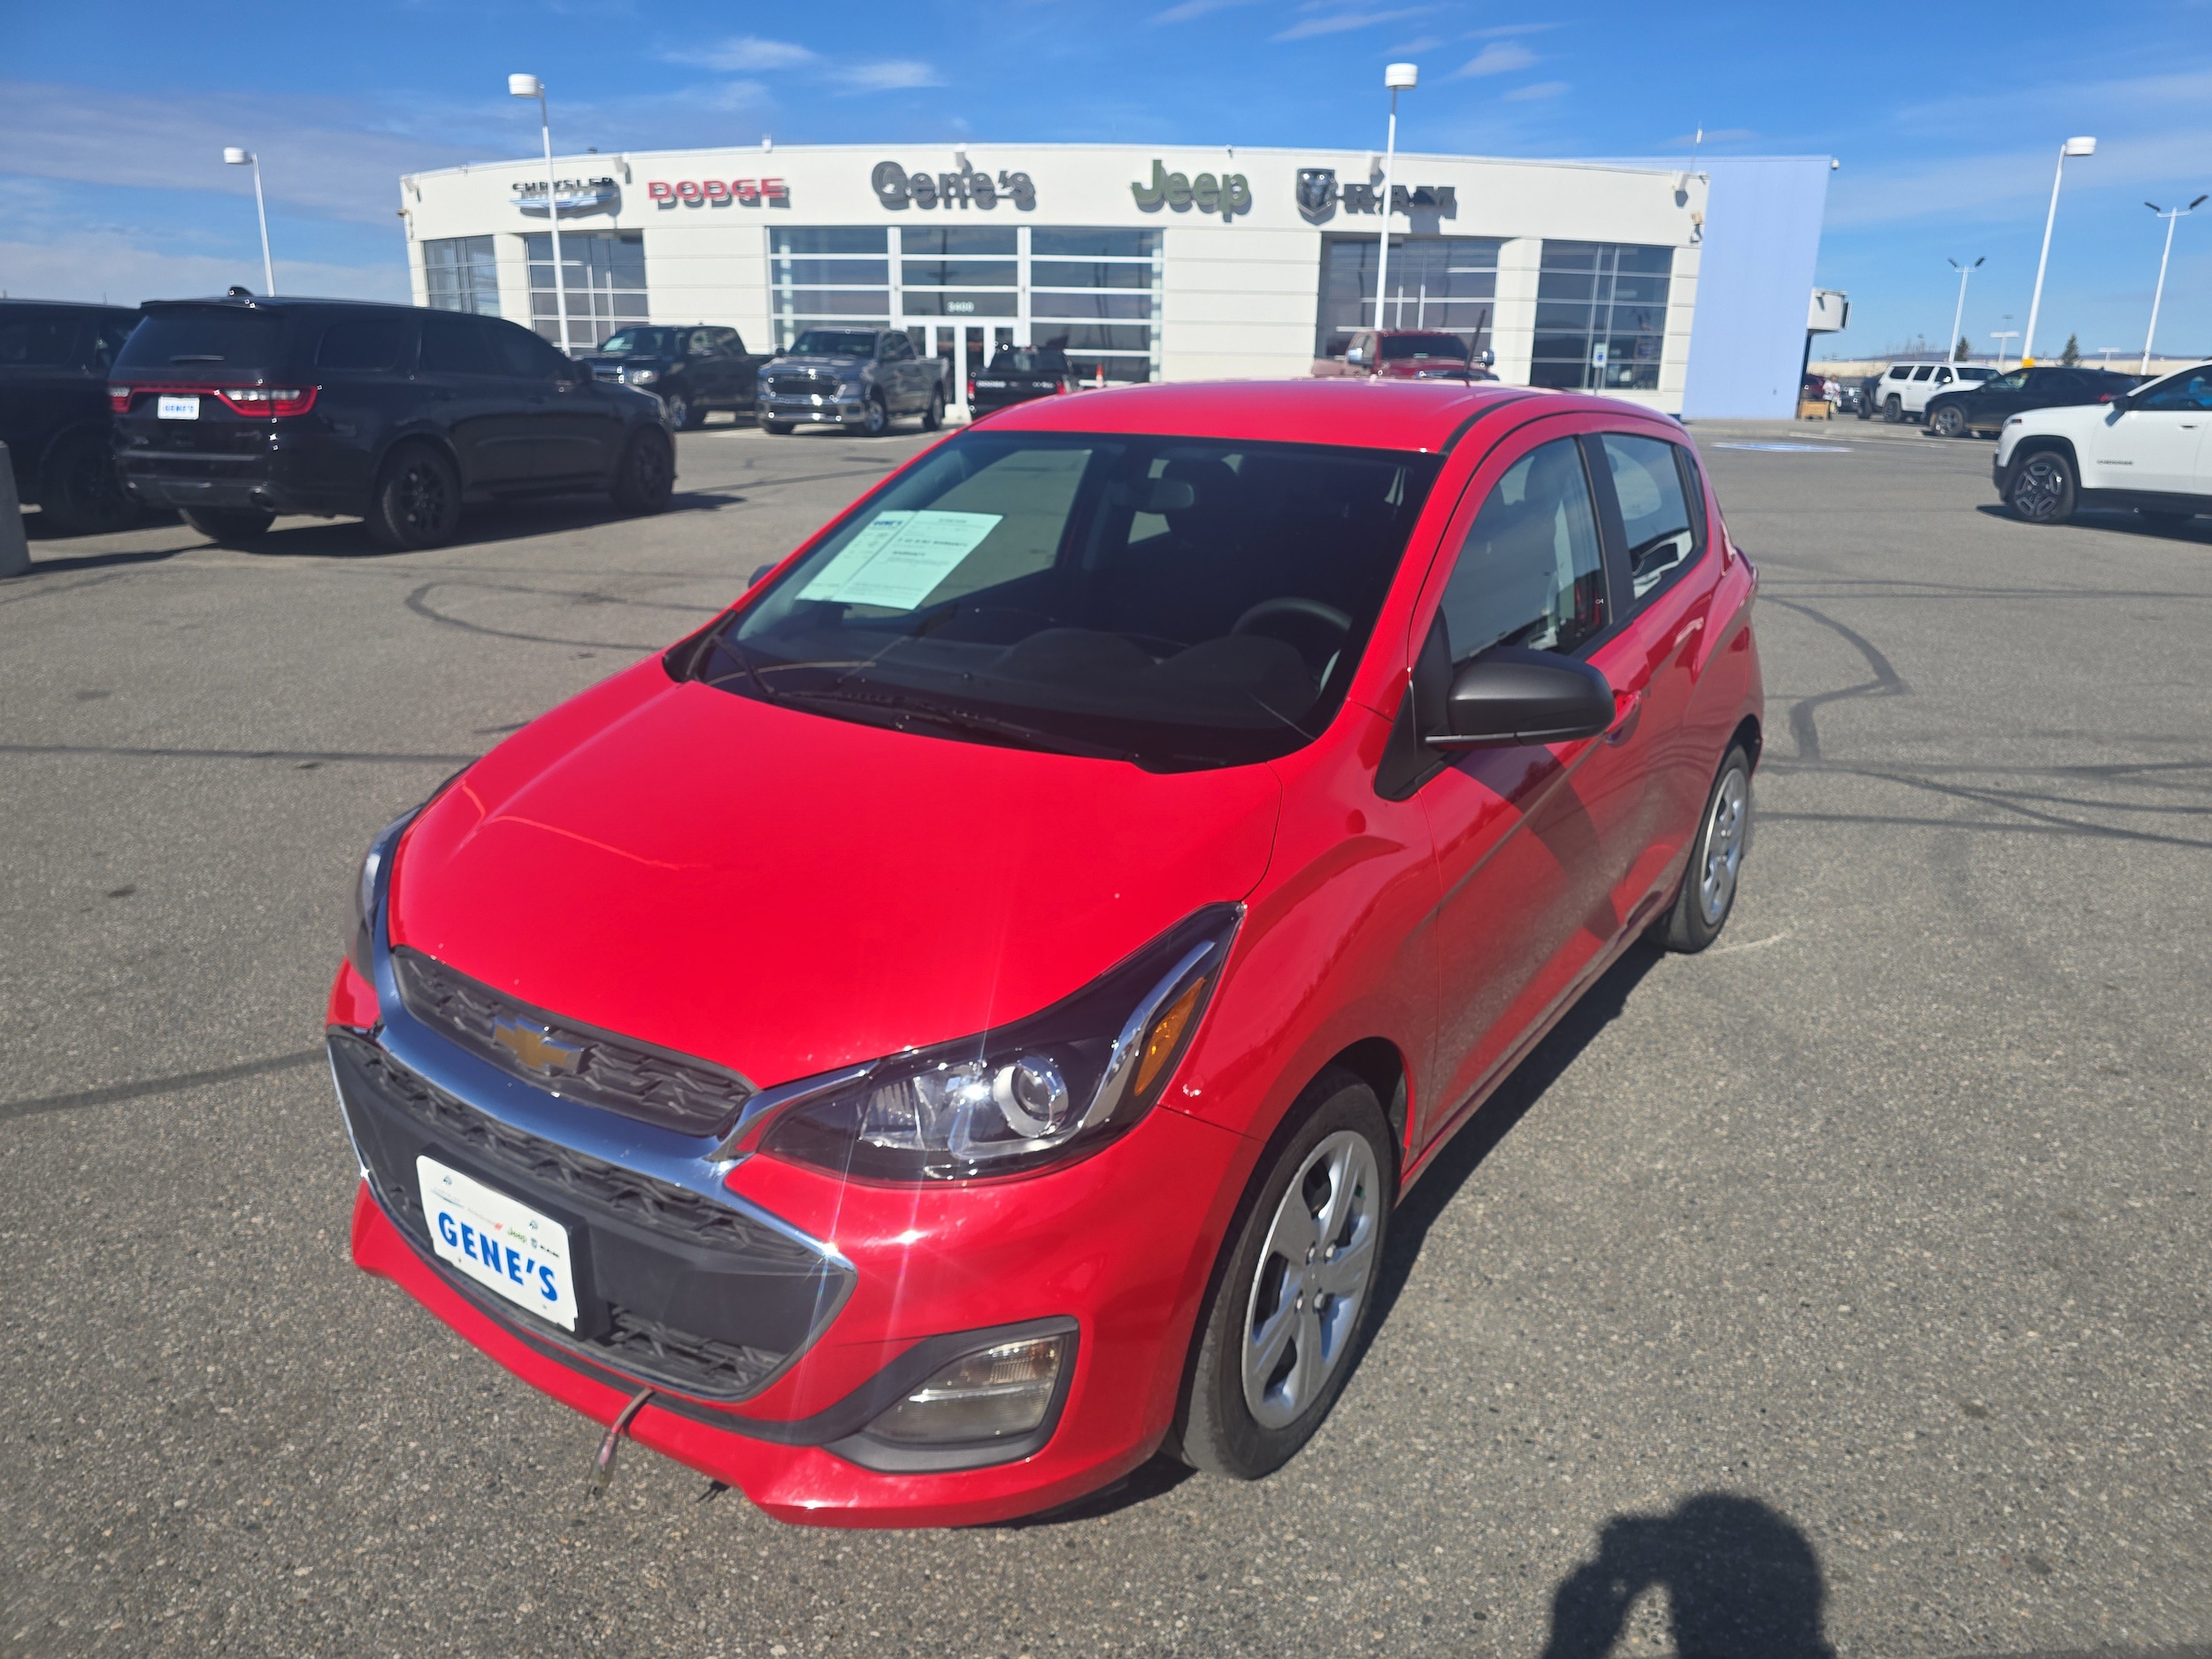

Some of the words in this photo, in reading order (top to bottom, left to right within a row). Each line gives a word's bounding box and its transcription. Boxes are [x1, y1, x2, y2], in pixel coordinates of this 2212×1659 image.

[648, 178, 785, 200] DODGE
[872, 160, 1036, 205] Gene's
[1131, 159, 1250, 215] Jeep
[437, 1211, 558, 1302] GENE'S
